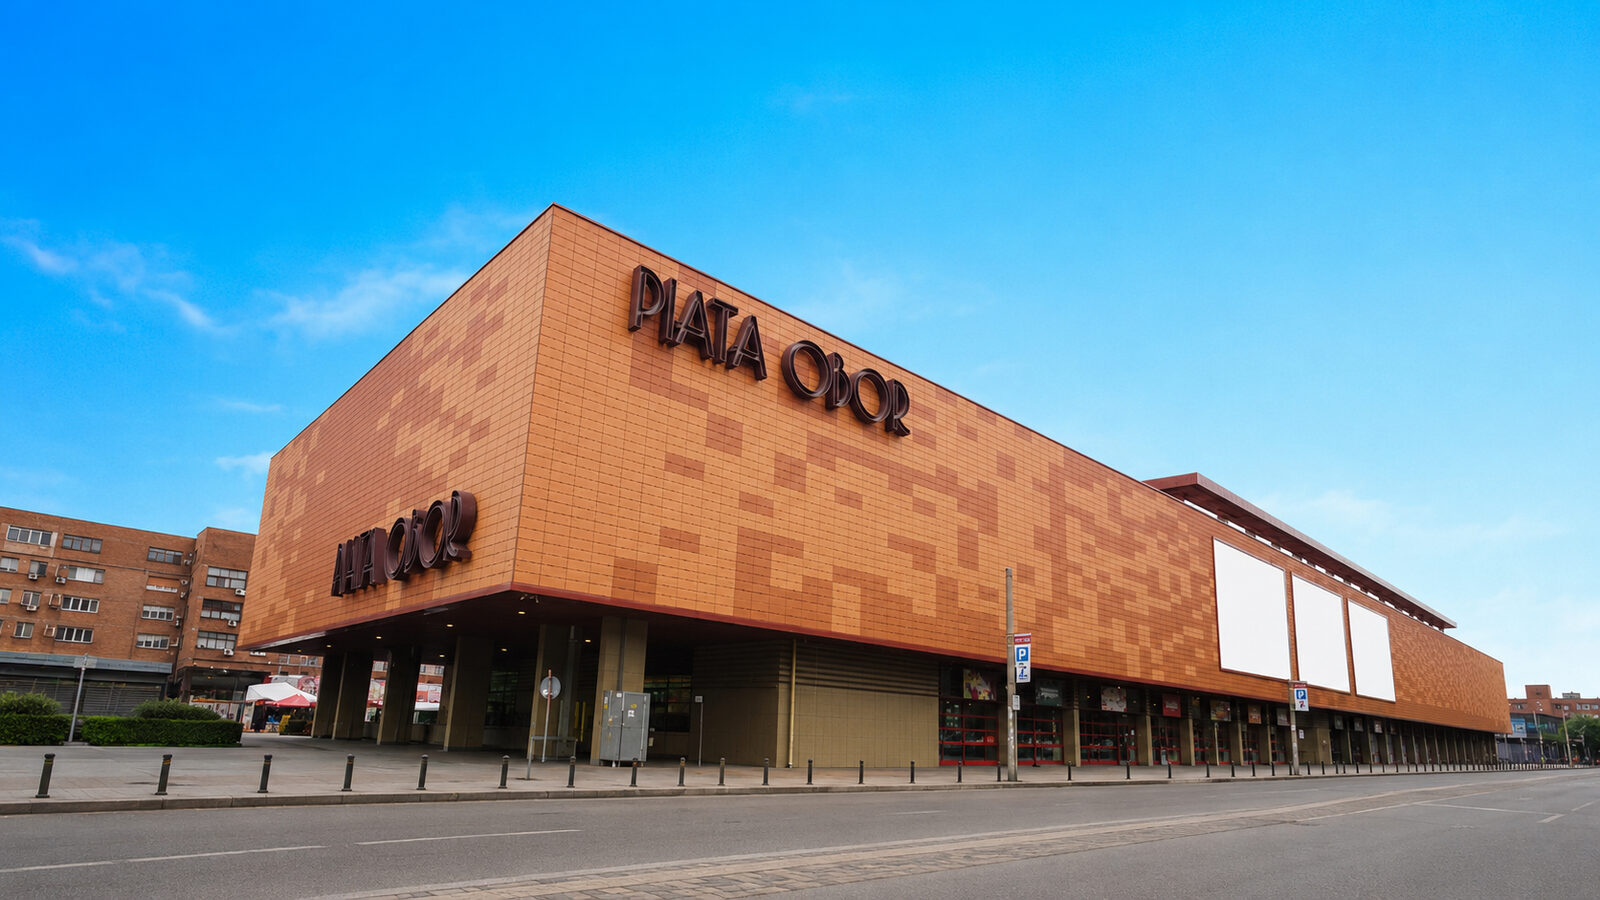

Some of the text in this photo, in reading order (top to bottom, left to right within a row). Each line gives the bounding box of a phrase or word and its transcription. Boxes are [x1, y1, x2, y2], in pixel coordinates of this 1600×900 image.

[628, 265, 911, 437] PIATA OBOR
[1019, 648, 1026, 660] P
